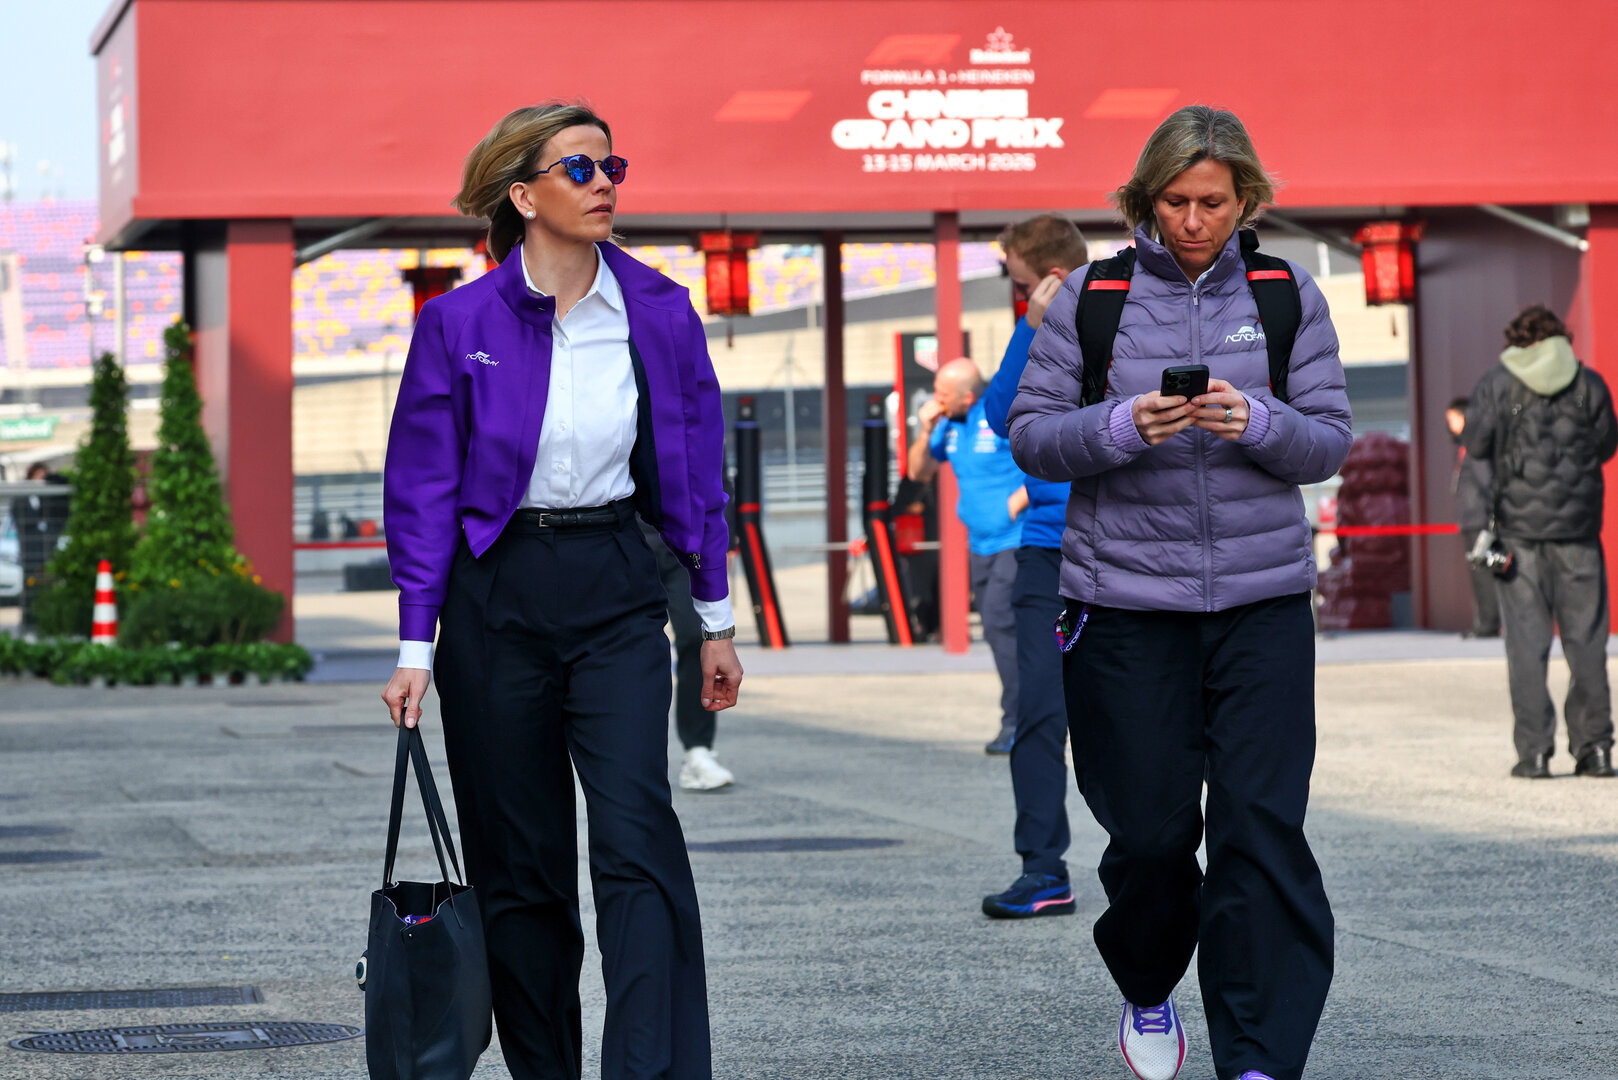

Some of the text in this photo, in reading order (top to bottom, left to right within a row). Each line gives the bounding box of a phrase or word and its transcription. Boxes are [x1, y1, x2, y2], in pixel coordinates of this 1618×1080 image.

[861, 69, 1035, 84] FORMULA 1 HEINEKEN
[831, 118, 1064, 149] GRAND PRIX
[914, 154, 986, 171] MARCH
[987, 153, 1036, 171] 2026
